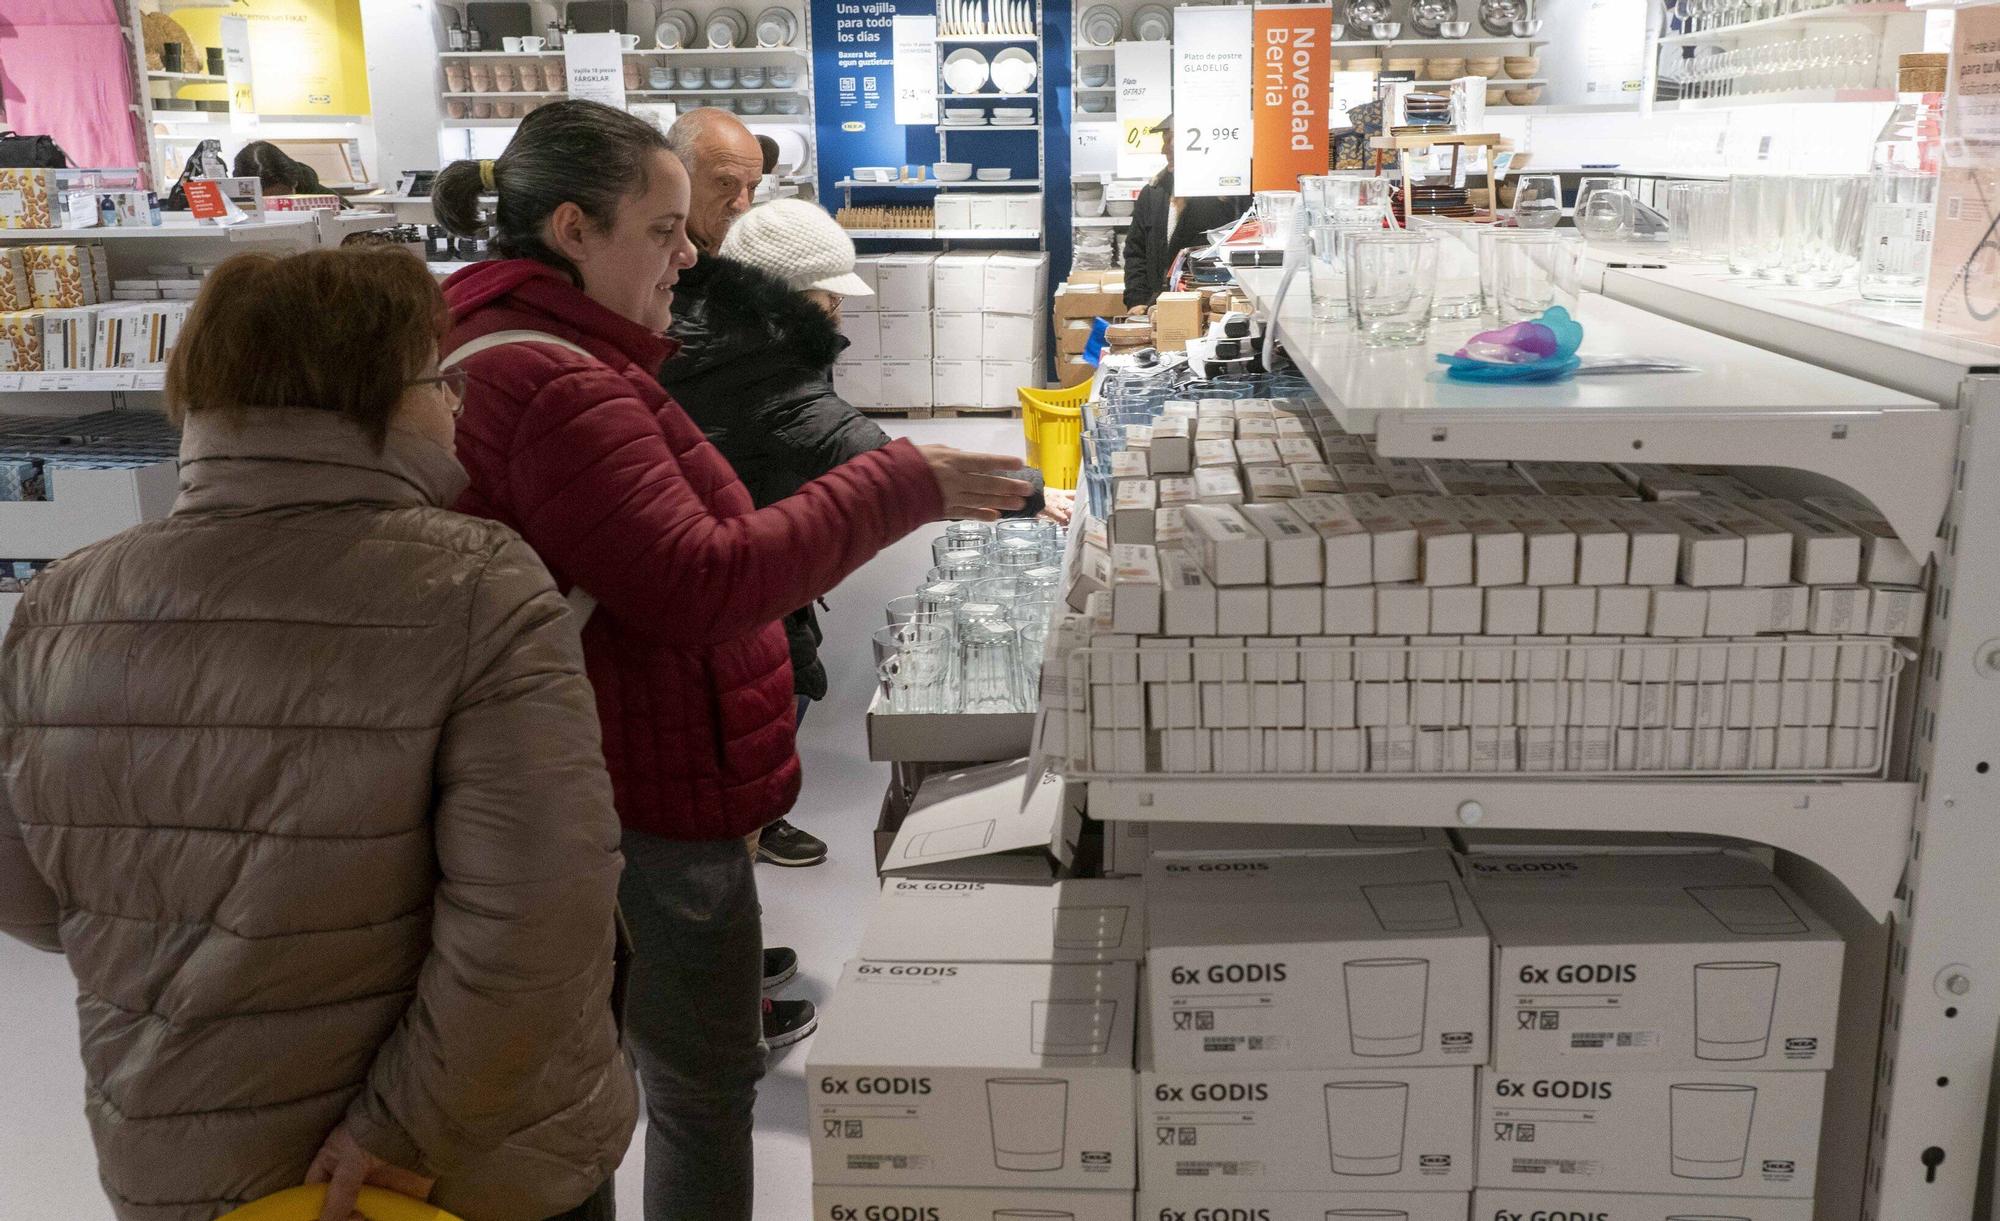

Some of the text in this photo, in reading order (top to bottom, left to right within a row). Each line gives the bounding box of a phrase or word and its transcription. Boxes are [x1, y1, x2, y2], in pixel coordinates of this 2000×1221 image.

[837, 3, 896, 16] Una vajilla
[837, 17, 893, 31] para todo
[837, 31, 881, 42] los días
[1217, 53, 1242, 61] postre
[1184, 64, 1229, 72] GLADELIG
[1265, 28, 1289, 107] Berria
[1291, 27, 1315, 151] Novedad
[1186, 127, 1239, 155] 2,99€
[1166, 862, 1270, 873] 6x GODIS
[1505, 861, 1579, 873] GODIS
[896, 882, 985, 890] 6x GODIS
[858, 965, 959, 976] 6x GODIS
[1171, 963, 1287, 985] 6x GODIS
[1519, 964, 1637, 984] 6x GODIS
[821, 1076, 932, 1095] 6x GODIS
[1155, 1082, 1269, 1102] 6x GODIS
[1496, 1079, 1612, 1100] 6x GODIS
[831, 1205, 940, 1221] 6x GODIS
[1159, 1208, 1271, 1221] 6x GODIS
[1529, 1210, 1609, 1221] GODIS
